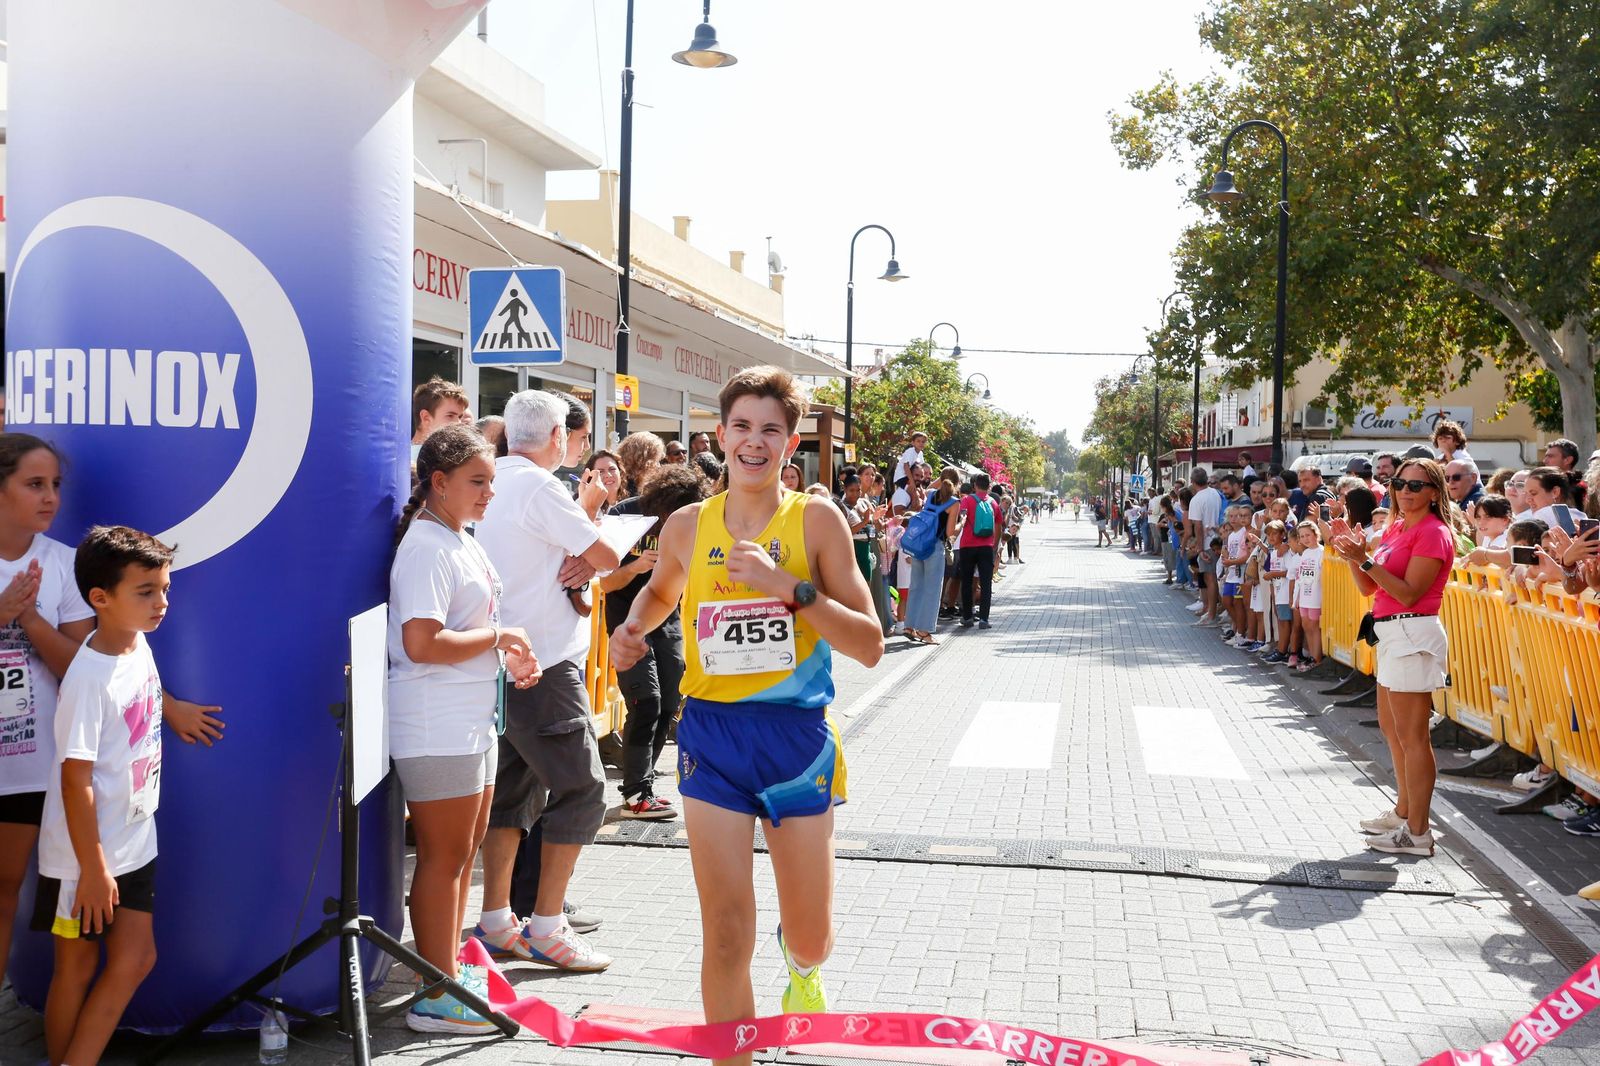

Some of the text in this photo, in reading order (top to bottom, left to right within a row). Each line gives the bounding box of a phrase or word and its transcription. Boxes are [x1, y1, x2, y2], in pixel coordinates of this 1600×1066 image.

[413, 248, 616, 351] CERV ALDILL
[5, 348, 241, 430] ACERINOX
[723, 619, 789, 646] 453
[349, 955, 363, 1001] VONYX
[924, 1017, 1137, 1066] CARRER
